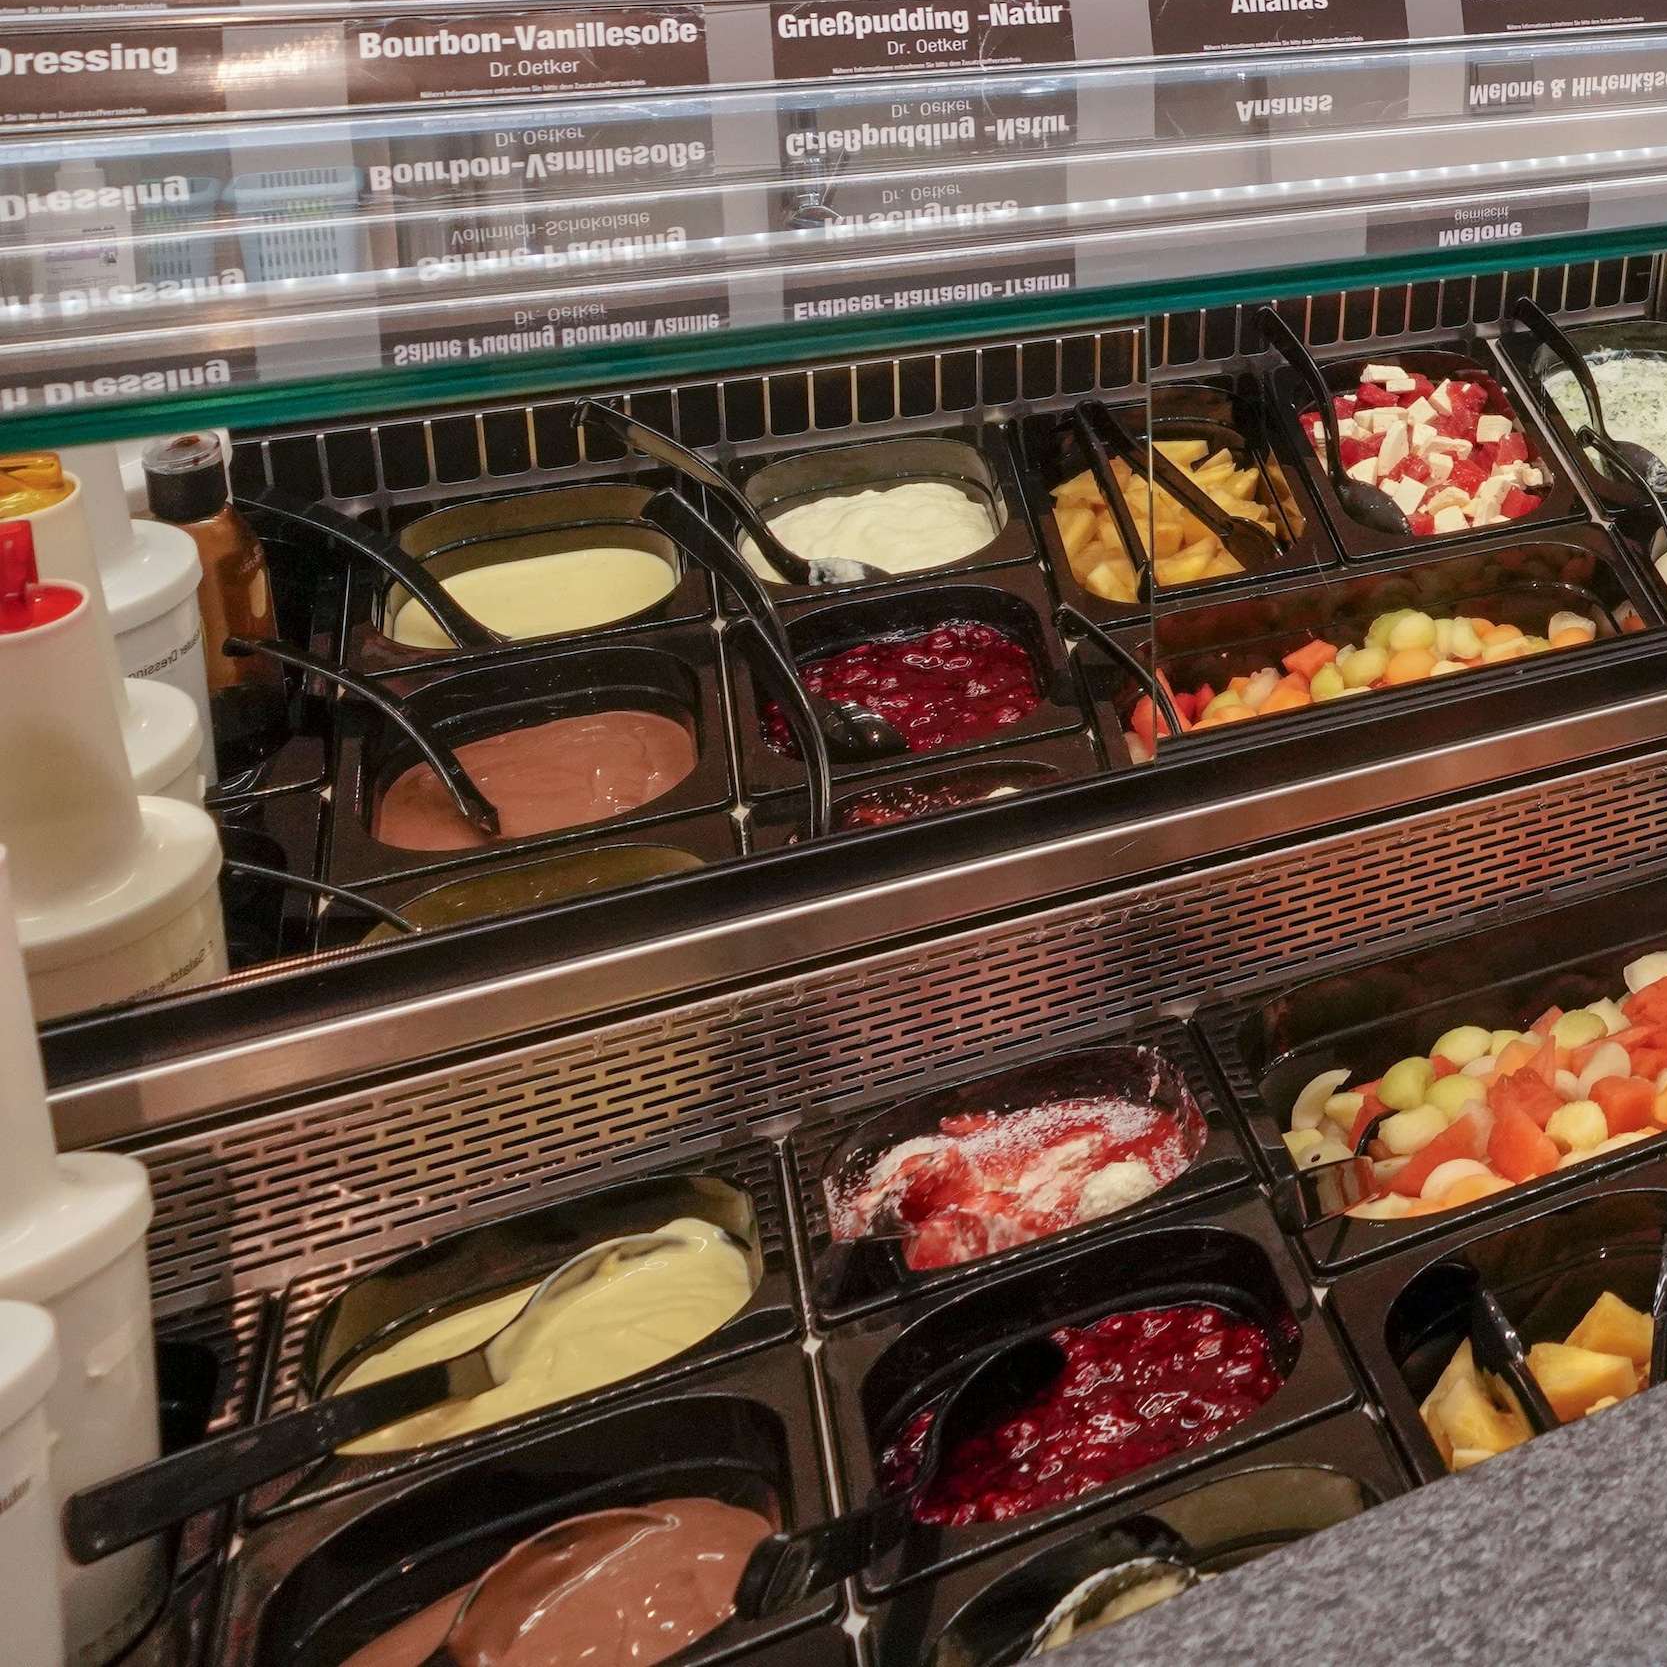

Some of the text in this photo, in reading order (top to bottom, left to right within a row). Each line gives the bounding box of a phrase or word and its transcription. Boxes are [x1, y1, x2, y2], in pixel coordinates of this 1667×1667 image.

[777, 2, 1063, 39] Grießpudding -Natur
[359, 18, 698, 59] Bourbon-Vanillesoße
[887, 39, 968, 56] Dr. Oetker
[531, 83, 541, 91] Sie
[542, 82, 558, 90] bitte
